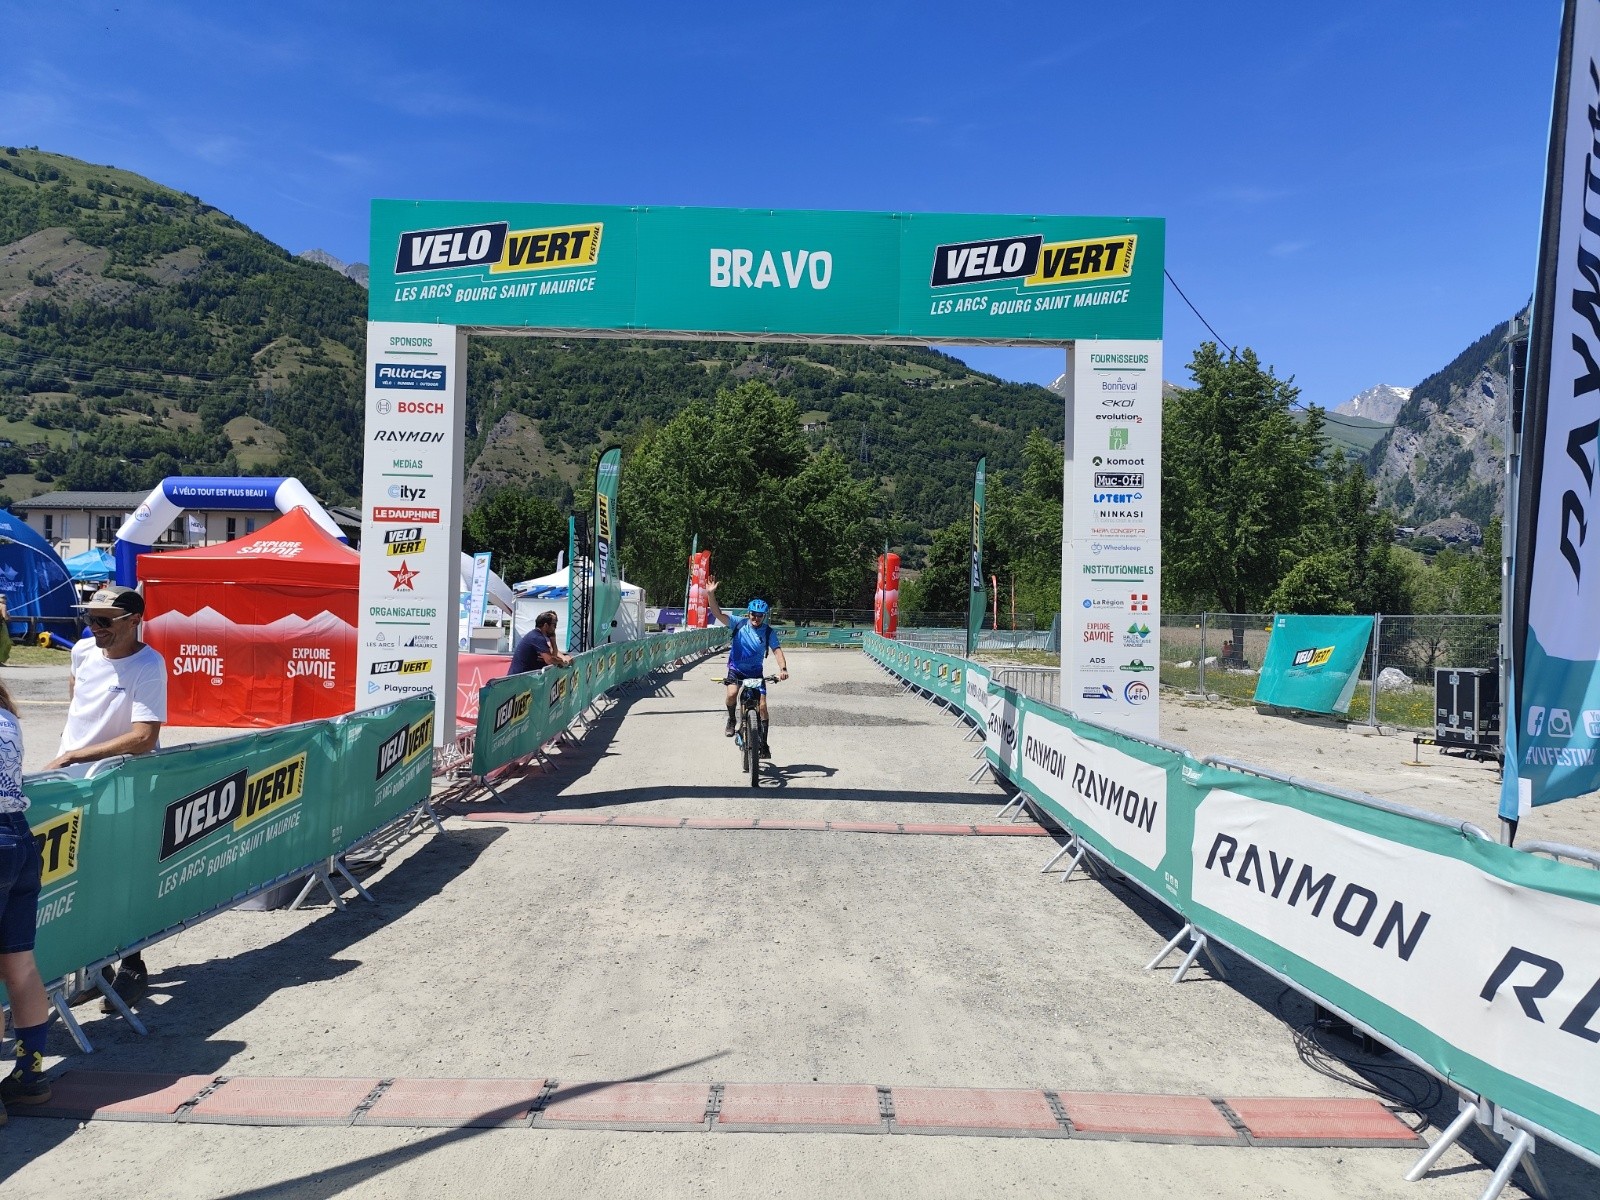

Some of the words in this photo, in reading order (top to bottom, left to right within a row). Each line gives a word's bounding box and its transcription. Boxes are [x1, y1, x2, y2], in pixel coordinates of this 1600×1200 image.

[411, 229, 491, 266] VELO
[508, 230, 590, 266] VERT
[589, 226, 600, 262] FESTIVAL
[947, 242, 1026, 279] VELO
[1043, 242, 1124, 279] VERT
[1122, 238, 1134, 273] FESTIVAL
[710, 248, 832, 290] BRAVO
[395, 286, 417, 302] LES
[419, 283, 452, 299] ARCS
[455, 286, 497, 303] BOURG
[500, 283, 537, 299] SAINT
[539, 277, 595, 297] MAURICE
[931, 301, 952, 315] LES
[954, 297, 988, 312] ARCS
[990, 299, 1031, 315] BOURG
[1034, 295, 1071, 312] SAINT
[1073, 290, 1129, 308] MAURICE
[390, 337, 433, 347] SPONSORS
[1102, 381, 1138, 391] Bonneval
[398, 402, 444, 414] BOSCH
[374, 430, 445, 443] RAYMON
[1107, 458, 1145, 466] komoot
[1097, 474, 1142, 486] Muc-Off
[173, 486, 178, 495] À
[180, 486, 196, 495] VÉLO
[229, 489, 244, 497] PLUS
[388, 485, 426, 501] Cityz
[375, 510, 388, 518] LE
[389, 529, 417, 543] VELO
[393, 541, 422, 554] VERT
[1083, 631, 1114, 643] SAVOIE
[180, 644, 218, 656] EXPLORE
[293, 648, 330, 659] EXPLORE
[1295, 650, 1313, 664] VELO
[173, 657, 224, 677] SAVOIE
[287, 660, 336, 680] SAVOIE
[374, 661, 400, 673] VELO
[404, 661, 429, 672] VERT
[384, 684, 433, 694] Playground
[380, 730, 405, 773] VELO
[408, 718, 431, 758] VERT
[1025, 735, 1066, 780] RAYMON
[174, 780, 236, 846] VELO
[246, 761, 300, 818] VERT
[1072, 763, 1158, 833] RAYMON
[68, 814, 80, 867] FESTIVAL
[158, 872, 178, 898] LES
[179, 856, 207, 886] ARCS
[207, 846, 239, 877] BOURG
[240, 832, 264, 858] SAINT
[265, 811, 301, 843] MAURICE
[1205, 832, 1431, 962] RAYMON
